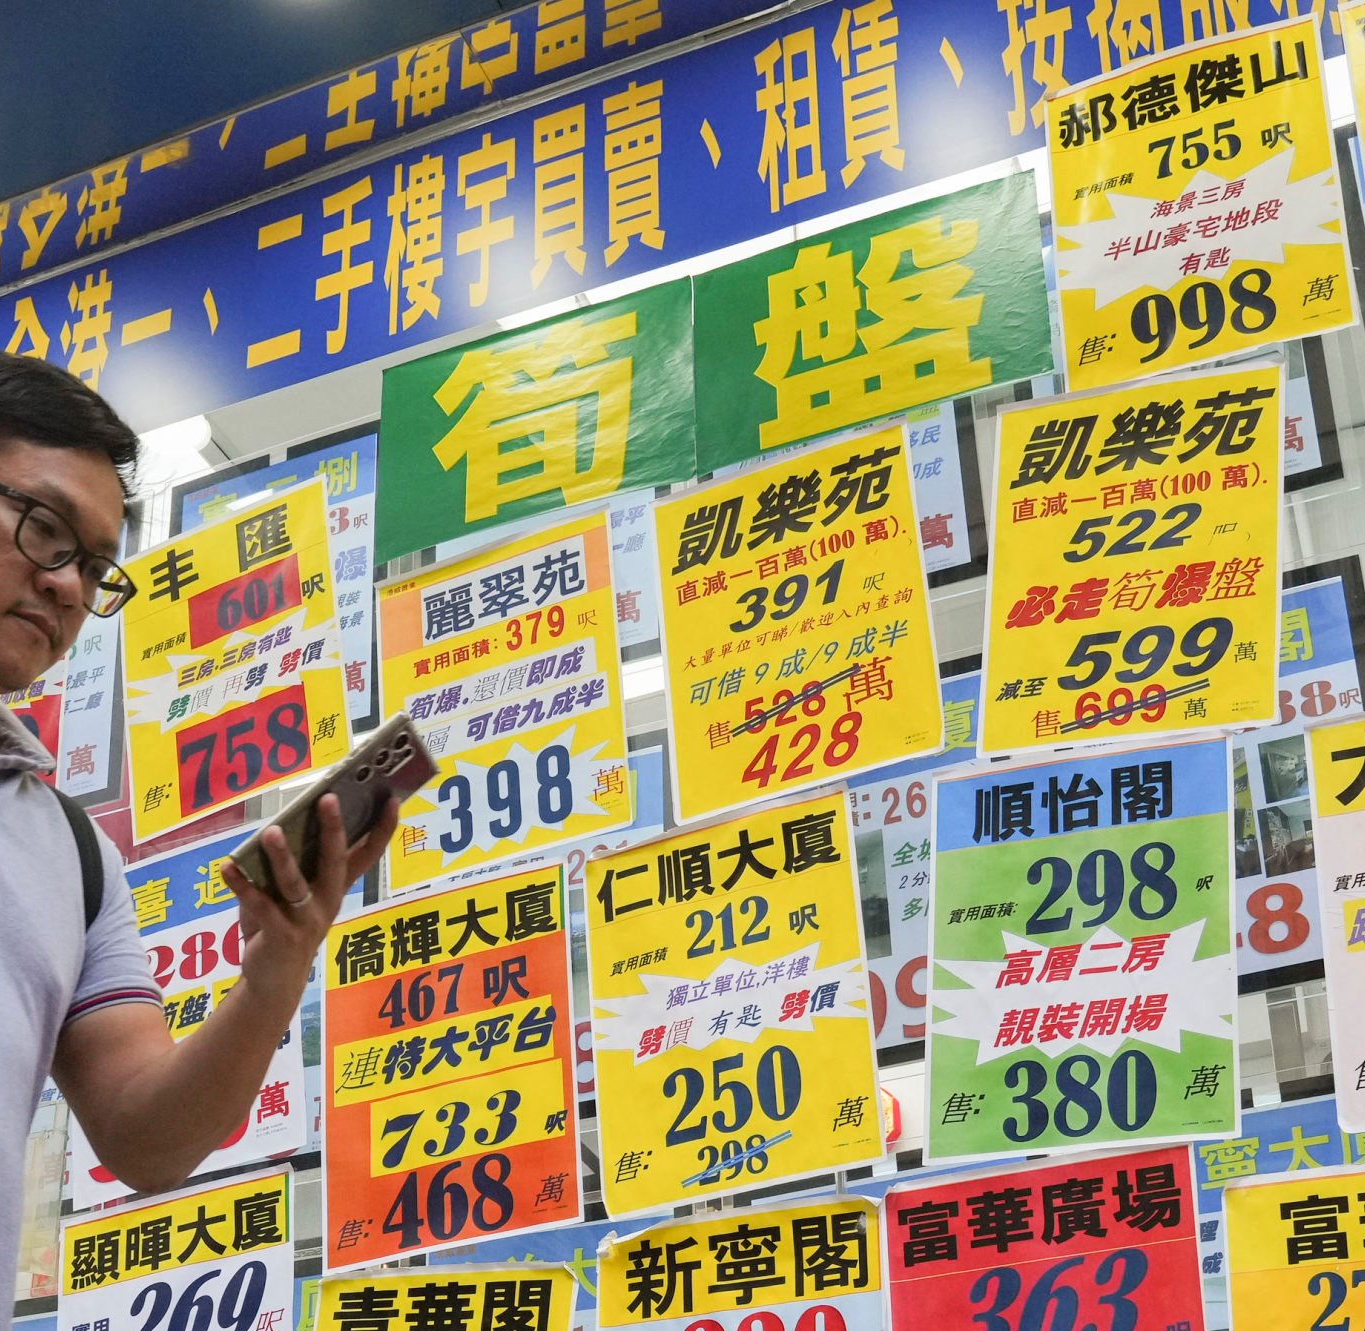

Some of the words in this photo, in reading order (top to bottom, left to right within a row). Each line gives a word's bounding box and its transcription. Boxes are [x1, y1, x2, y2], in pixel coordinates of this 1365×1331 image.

[1058, 39, 1311, 153] 郝德傑山
[1148, 116, 1244, 181] 755
[1106, 198, 1284, 262] 半山豪宅地段
[1130, 266, 1280, 366] 998
[434, 218, 995, 524] 筍盤
[1009, 386, 1276, 491] 凱樂苑
[672, 444, 902, 576] 凱樂苑
[1062, 502, 1203, 563] 522
[216, 568, 287, 632] 601
[422, 548, 589, 642] 麗翠苑
[506, 606, 566, 651] 379
[729, 559, 845, 634] 391
[1005, 556, 1265, 630] 必走筍爆盤
[1057, 616, 1234, 691] 599
[177, 700, 311, 812] 758
[741, 711, 864, 790] 428
[436, 743, 573, 855] 398
[973, 762, 1174, 846] 順怡閣
[595, 809, 843, 923] 仁順大廈
[1026, 841, 1178, 936] 298
[335, 881, 559, 985] 僑輝大廈
[685, 895, 771, 960] 212
[995, 933, 1172, 990] 高層二房
[378, 964, 465, 1030] 467
[994, 993, 1169, 1049] 靚裝開揚
[337, 1006, 556, 1093] 連特大平台
[663, 1045, 802, 1148] 250
[1003, 1050, 1157, 1143] 380
[70, 1189, 285, 1292] 顯暉大廈
[382, 1153, 515, 1251] 468
[898, 1164, 1184, 1267] 富華廣場
[625, 1211, 870, 1319] 新寧閣
